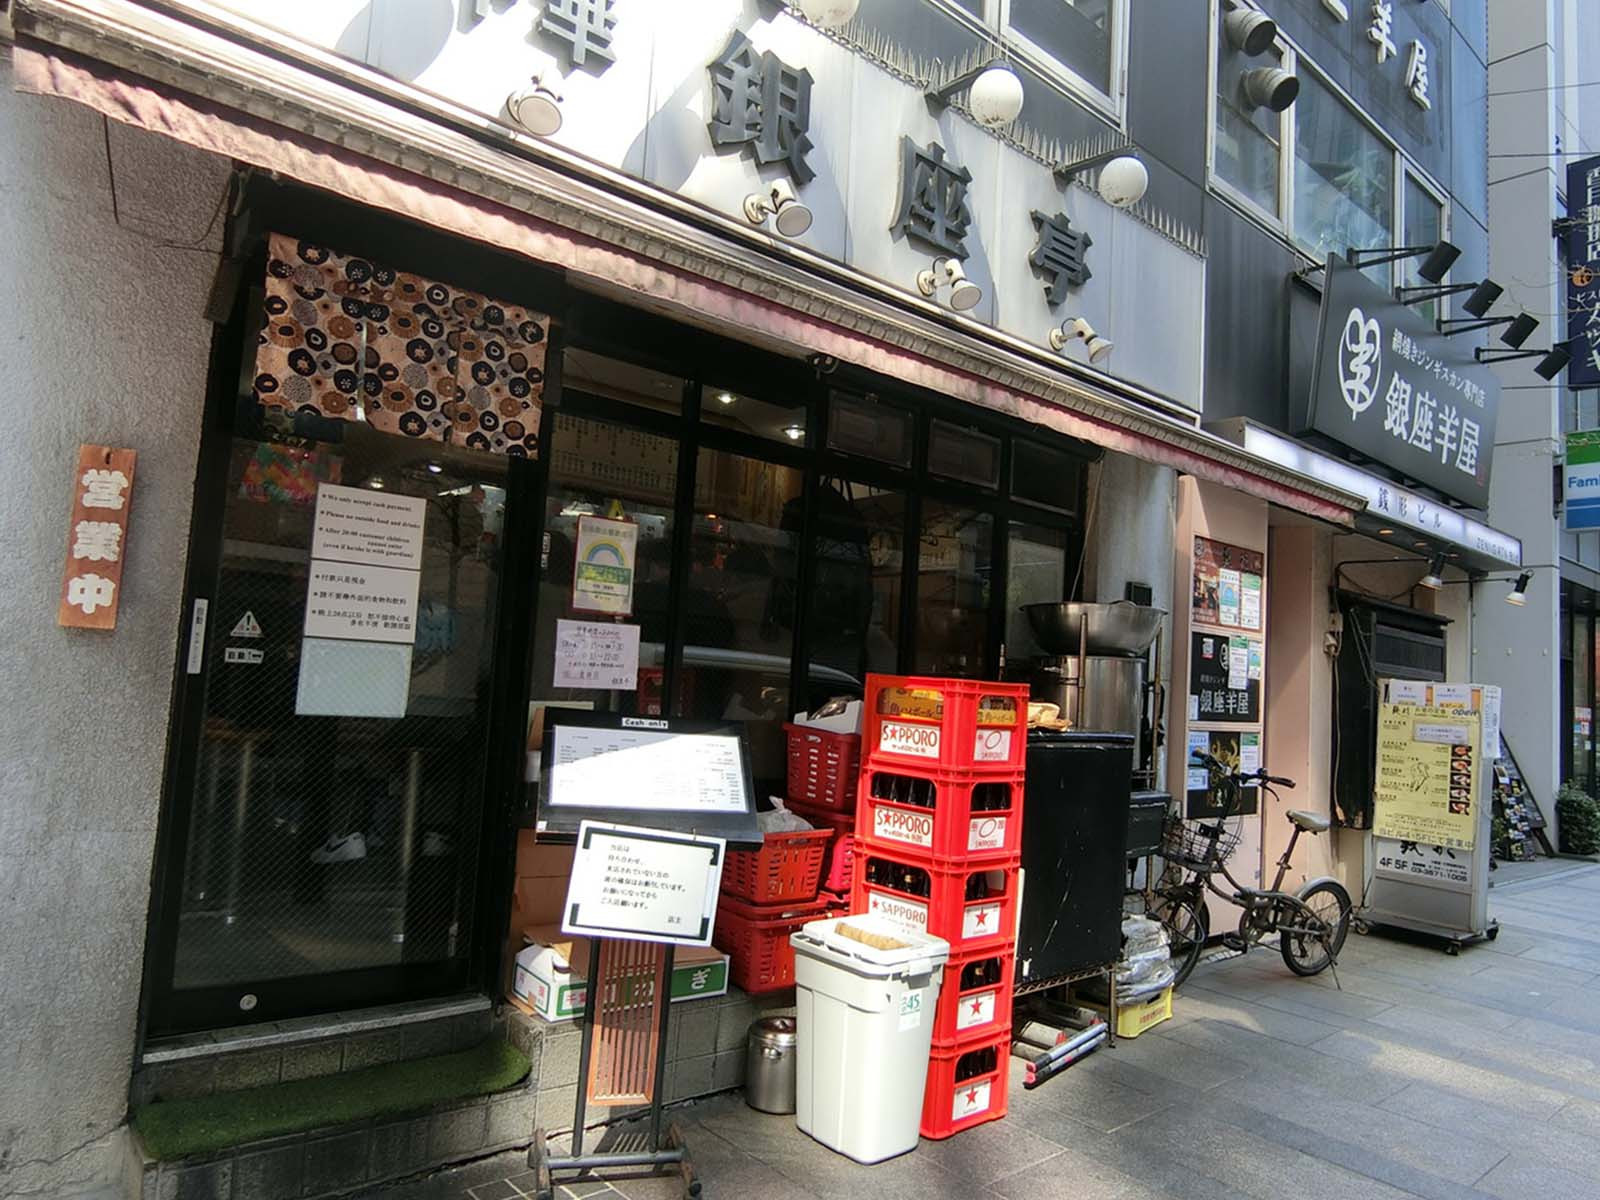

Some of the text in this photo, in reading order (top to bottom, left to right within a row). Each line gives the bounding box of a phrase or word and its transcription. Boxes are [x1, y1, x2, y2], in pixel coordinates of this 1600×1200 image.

[1384, 371, 1481, 477] 銀座羊屋
[326, 511, 344, 519] Please
[325, 527, 340, 535] After
[67, 469, 129, 614] 営業中
[1200, 688, 1249, 714] 銀座羊屋
[624, 719, 668, 729] Cash only
[1380, 857, 1393, 868] 4F
[1394, 859, 1408, 870] 5F
[881, 901, 926, 925] SAPPORO
[907, 995, 921, 1010] 45
